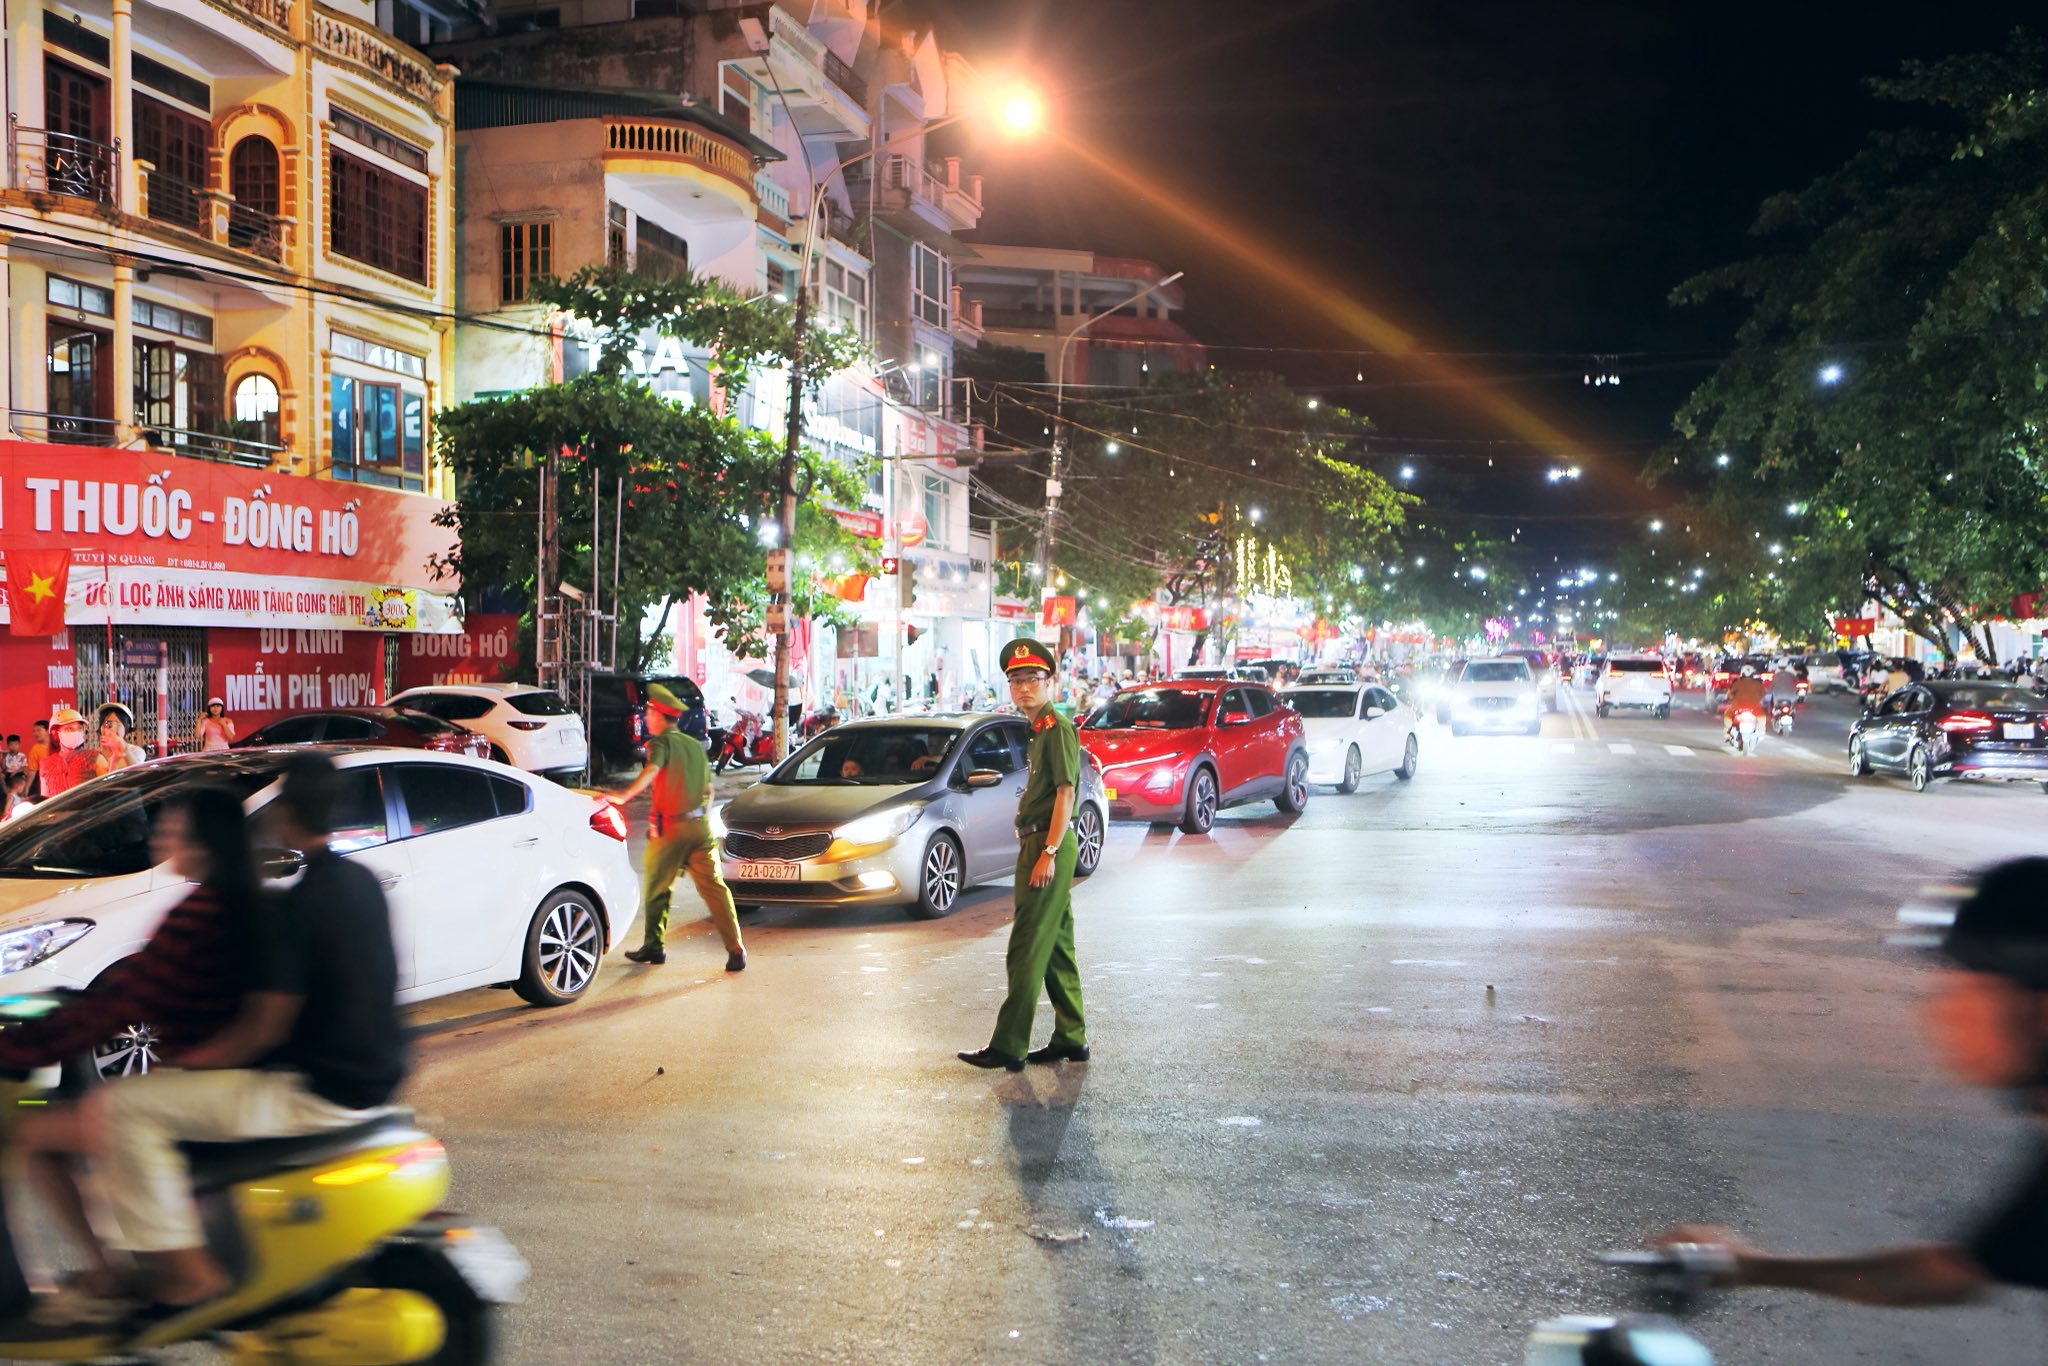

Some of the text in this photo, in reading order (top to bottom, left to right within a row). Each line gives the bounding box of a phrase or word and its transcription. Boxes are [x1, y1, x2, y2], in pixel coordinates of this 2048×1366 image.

[26, 470, 193, 540] THUỐC
[222, 484, 313, 552] ĐỒNG
[320, 498, 361, 557] HỒ
[119, 554, 155, 567] QUANG
[120, 582, 150, 612] LỌC
[189, 582, 223, 609] SÁNG
[228, 588, 259, 611] XANH
[263, 587, 293, 618] TẶNG
[297, 592, 326, 618] GỌNG
[479, 626, 508, 657] HỒ
[48, 661, 73, 688] TRÒNG
[226, 661, 376, 711] MIỄN PHÍ 100%
[740, 864, 797, 879] 22A-028.77
